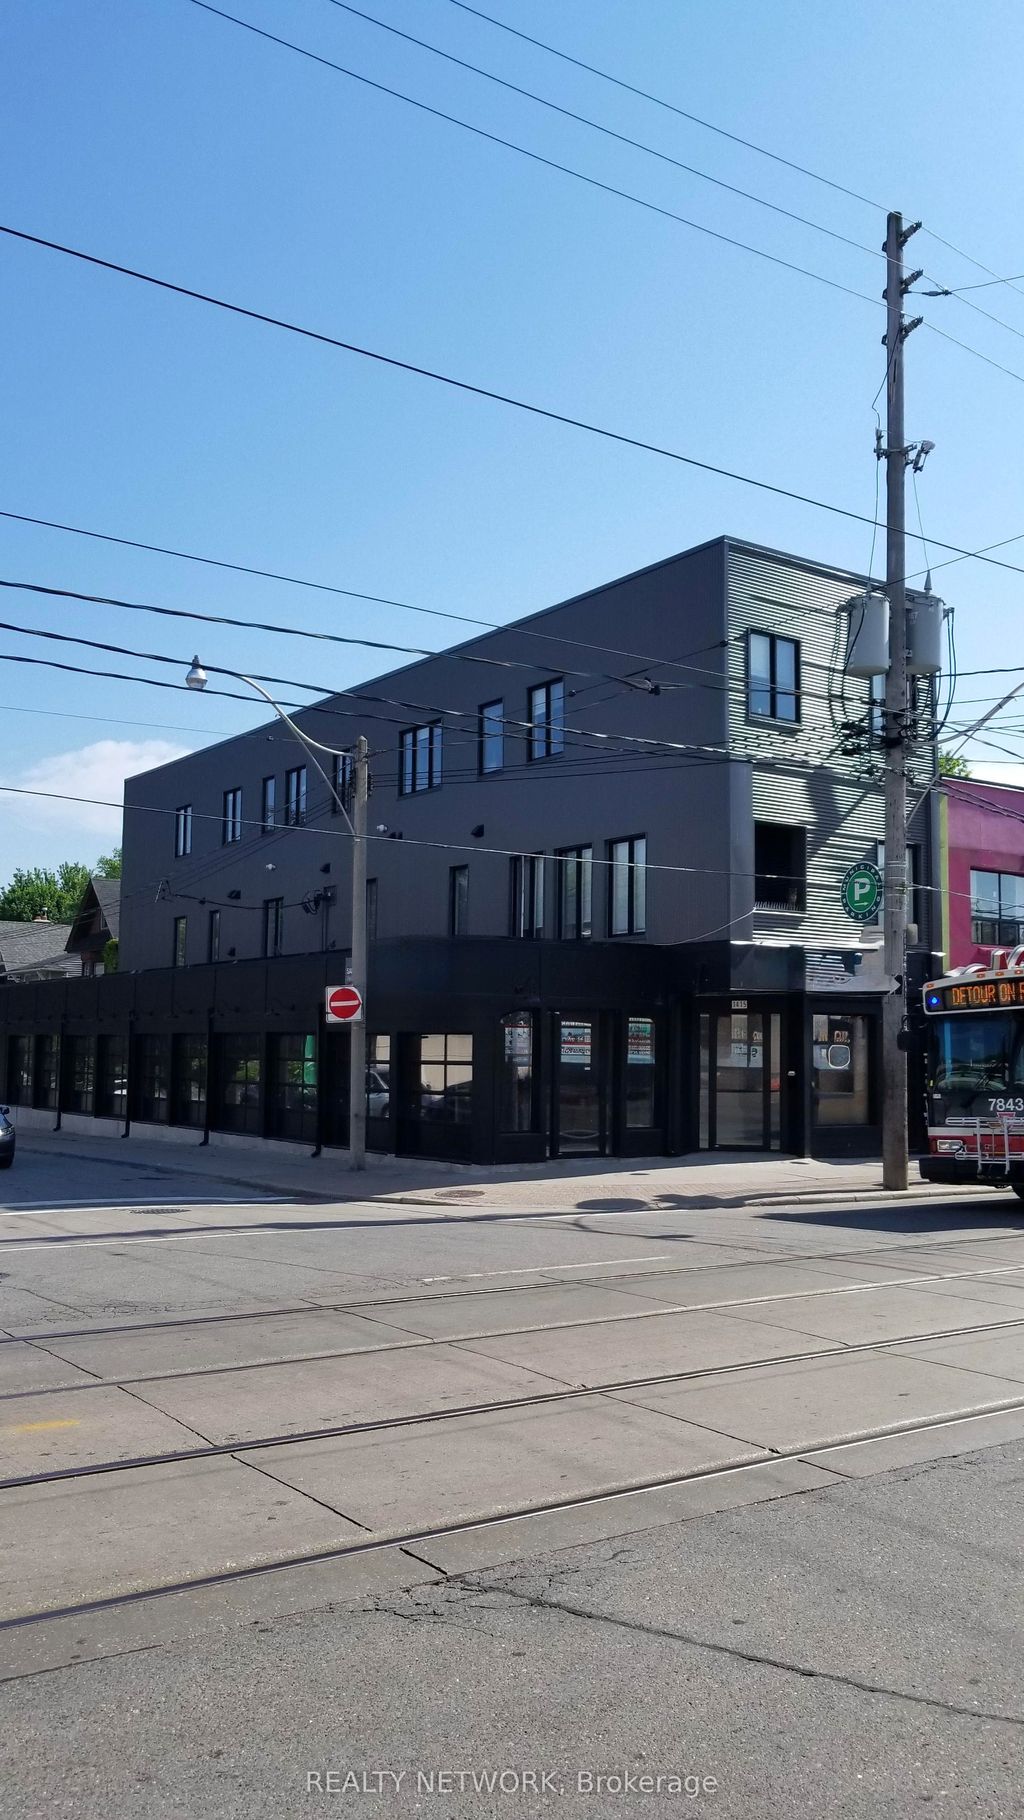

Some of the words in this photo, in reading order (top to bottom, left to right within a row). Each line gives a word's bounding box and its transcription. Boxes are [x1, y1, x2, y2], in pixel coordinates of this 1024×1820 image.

[842, 865, 882, 891] MUNICIPAL
[854, 877, 871, 901] P
[842, 896, 881, 919] PARKING
[952, 984, 996, 1005] DETOUR
[999, 982, 1016, 1002] ON
[988, 1098, 1024, 1112] 7843
